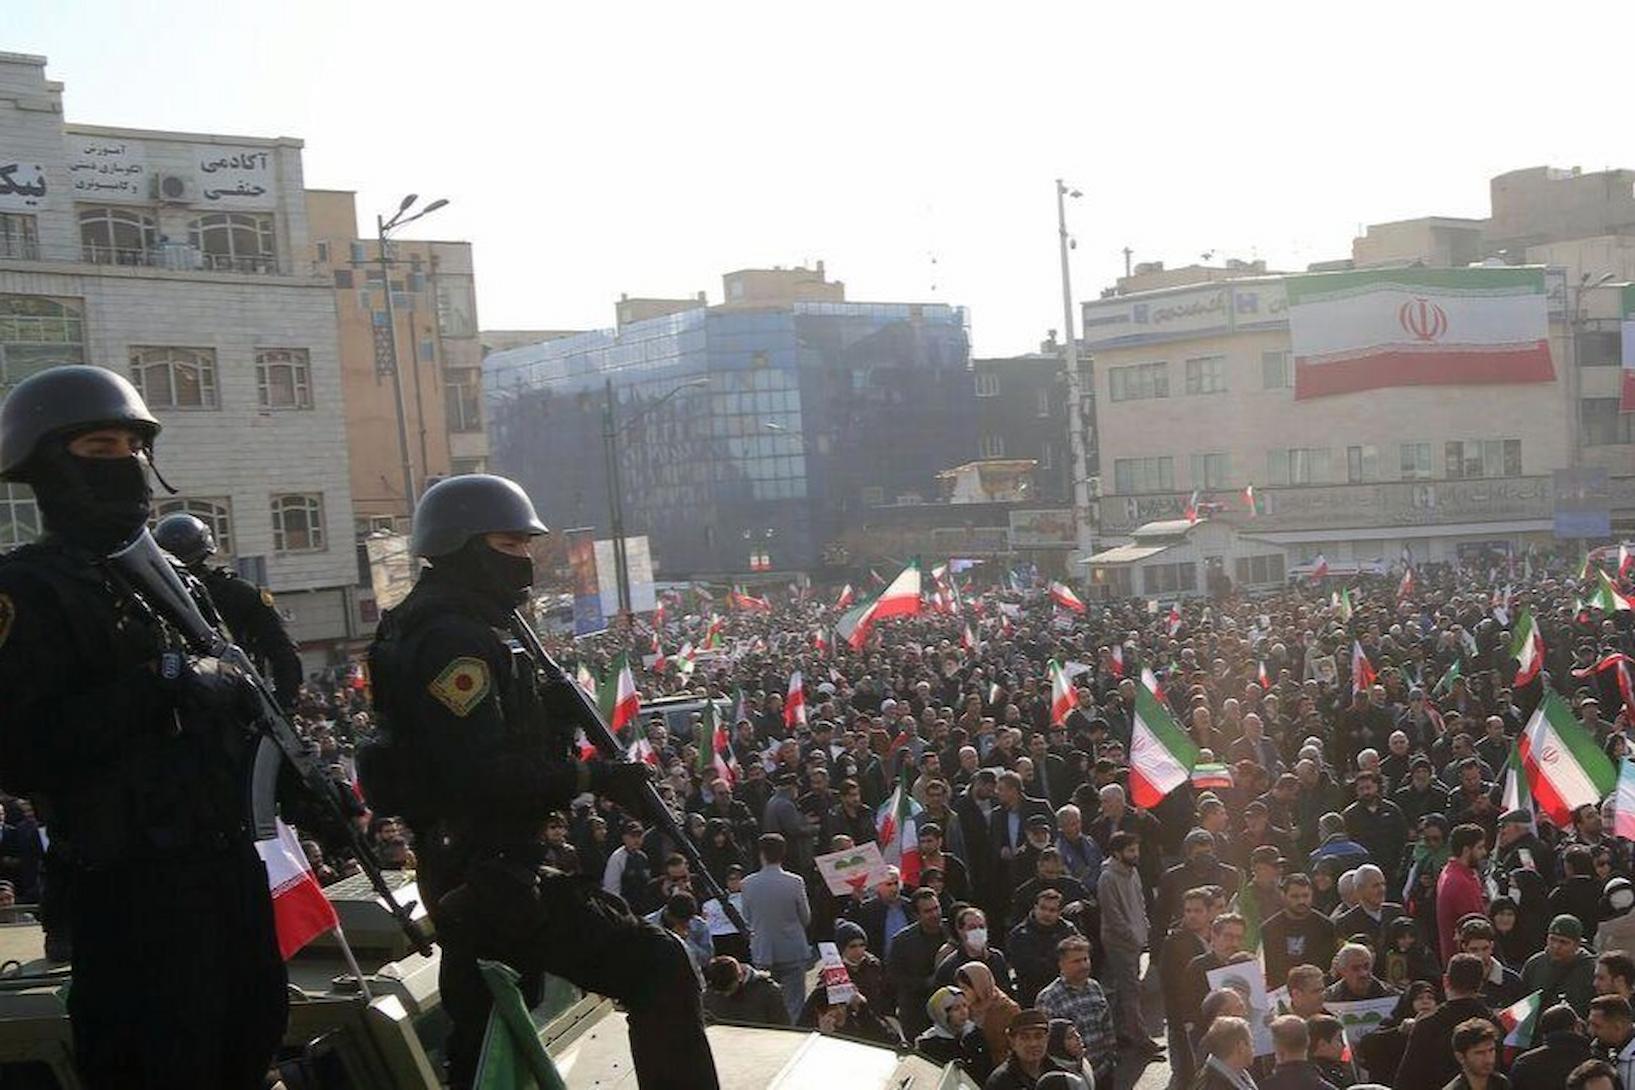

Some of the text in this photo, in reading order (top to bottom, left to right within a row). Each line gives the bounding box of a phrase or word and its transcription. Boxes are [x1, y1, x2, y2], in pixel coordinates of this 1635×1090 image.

[83, 143, 126, 156] آموزش
[201, 151, 268, 173] آکادمی
[204, 180, 266, 200] حنفی
